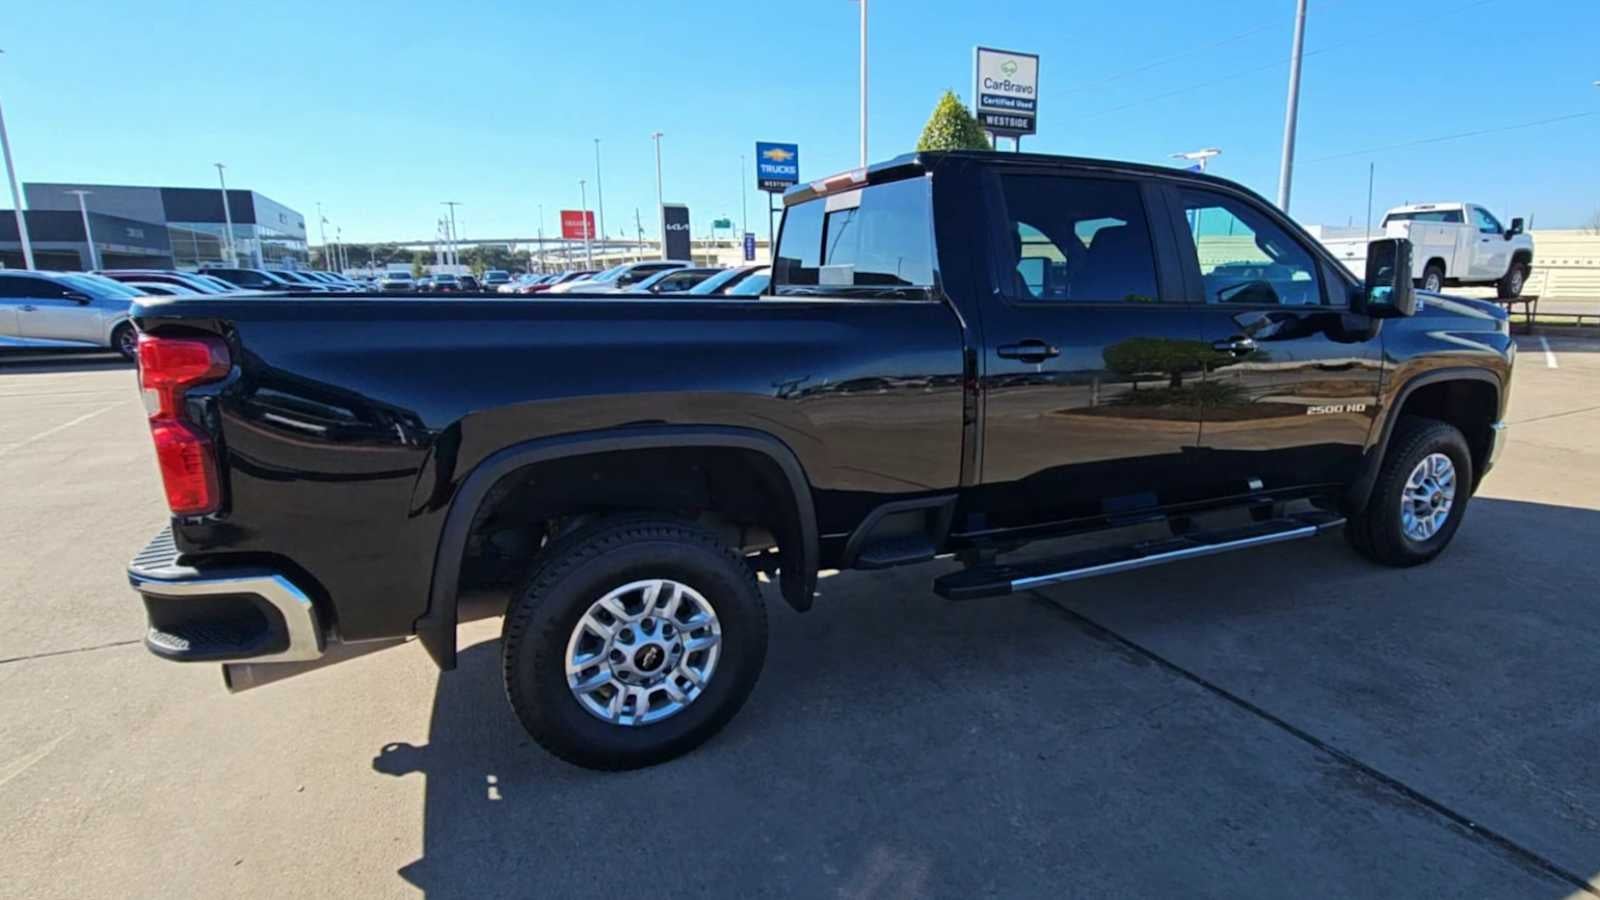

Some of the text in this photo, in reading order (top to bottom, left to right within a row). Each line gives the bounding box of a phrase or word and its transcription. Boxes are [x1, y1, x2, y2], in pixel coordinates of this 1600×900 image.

[984, 77, 1033, 94] CarBravo
[983, 97, 1033, 108] Certified Used
[986, 116, 1028, 128] WESTSIDE
[760, 164, 796, 174] TRUCKS
[1307, 403, 1366, 415] 2500 HD
